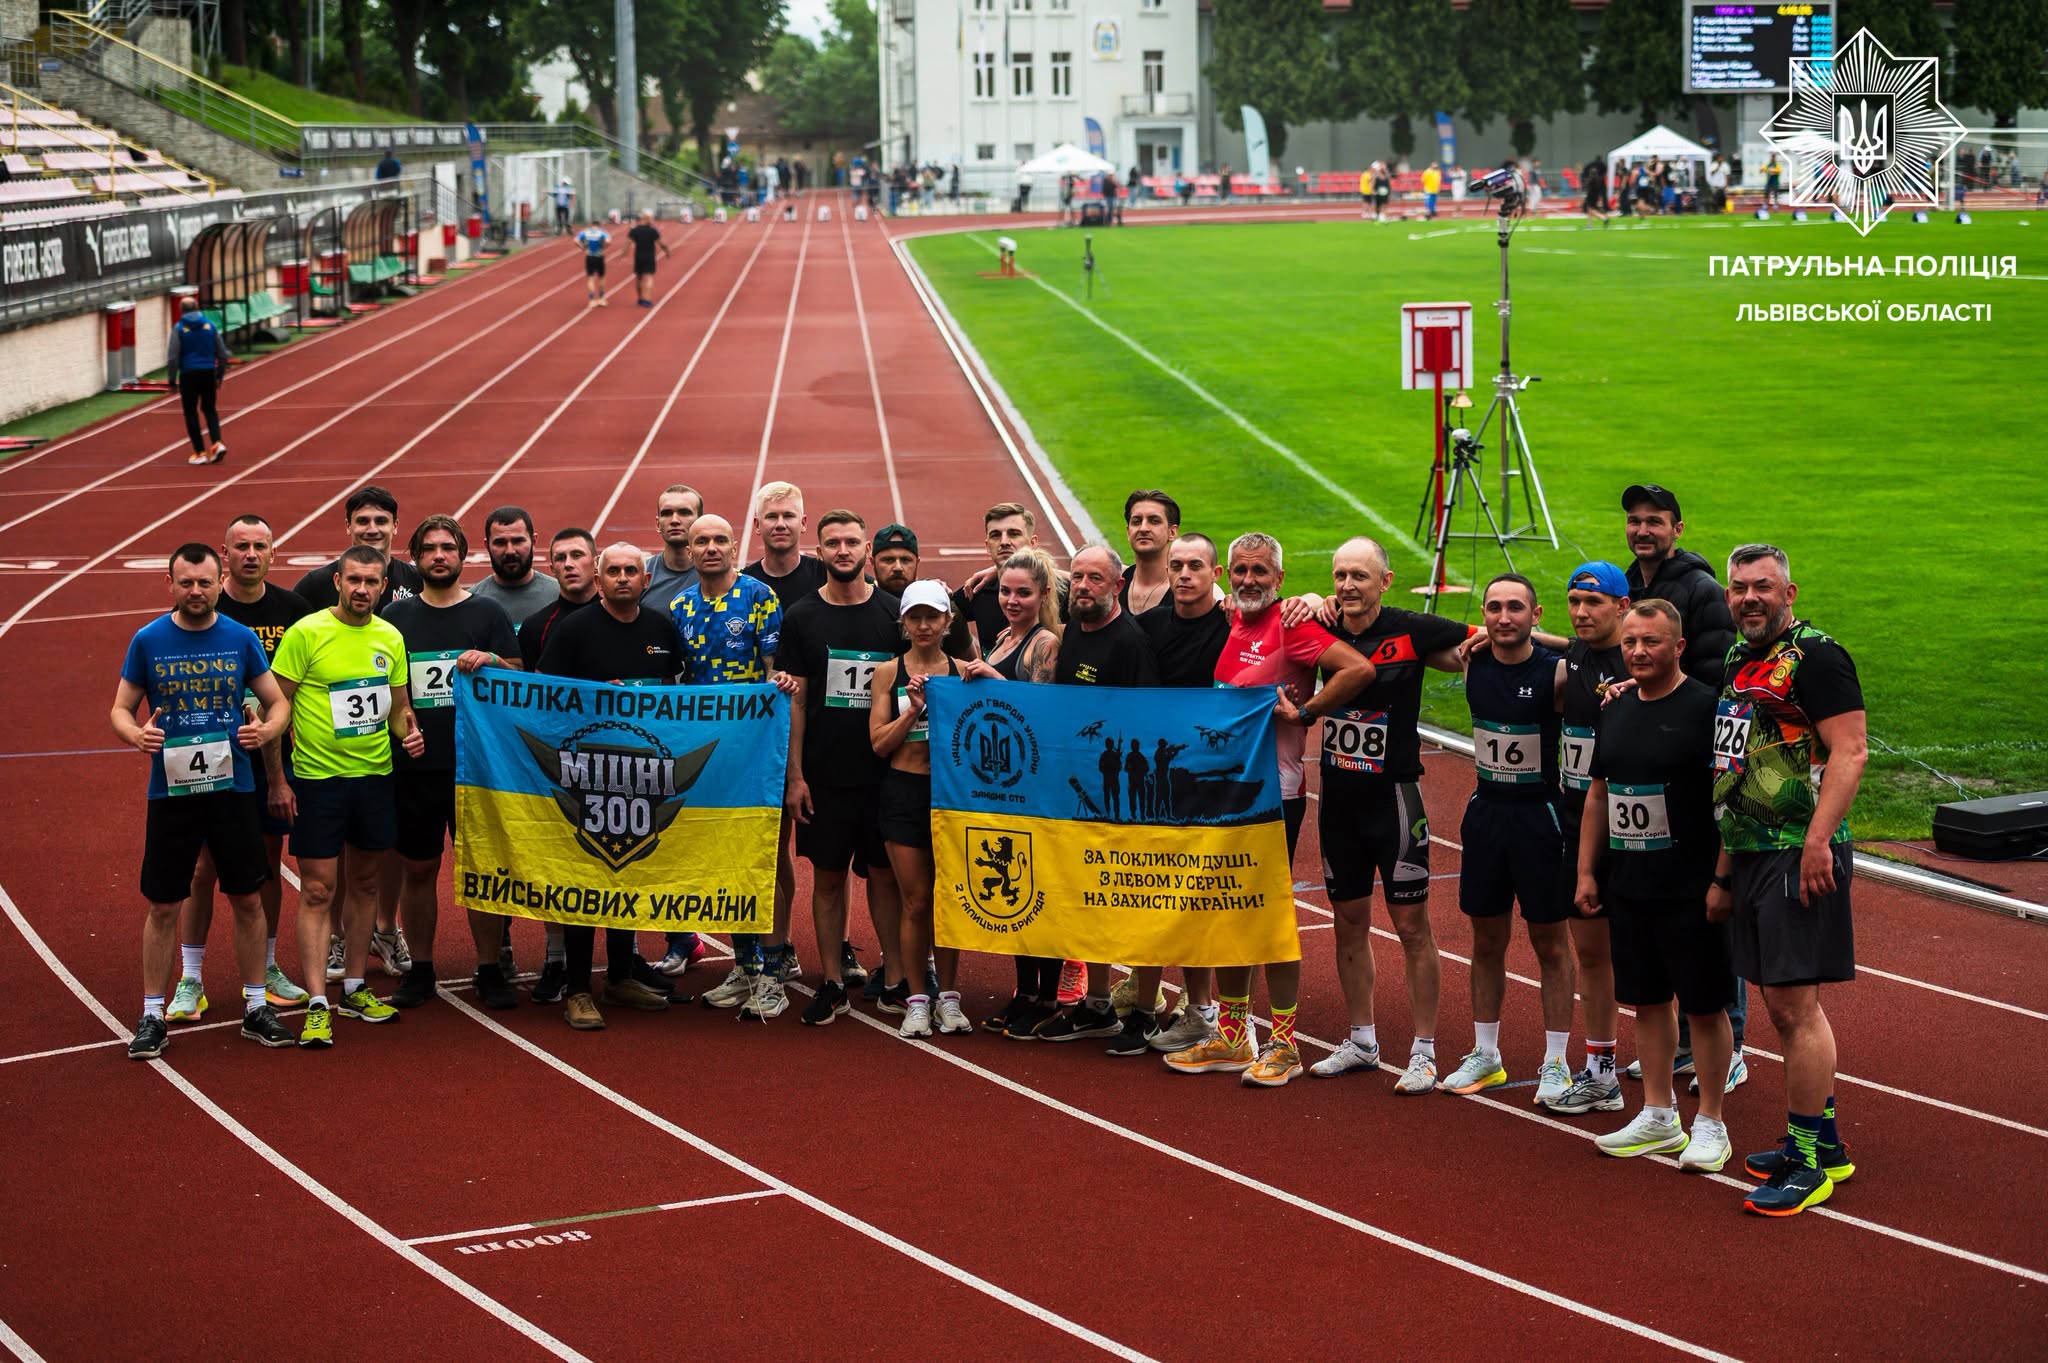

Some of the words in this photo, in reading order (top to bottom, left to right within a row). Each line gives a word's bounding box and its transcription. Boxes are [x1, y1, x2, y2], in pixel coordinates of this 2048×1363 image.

[249, 626, 285, 639] TUS
[155, 658, 238, 678] STRONG
[844, 666, 875, 690] 12
[347, 692, 379, 718] 31
[472, 676, 585, 715] СПІЛКА
[595, 689, 777, 722] ПОРАНЕНИХ
[952, 699, 984, 767] НАЦІОНАЛЬНА
[986, 698, 1025, 724] ГВАРДІЯ
[1024, 724, 1041, 775] УКРАЇНИ
[1325, 719, 1385, 757] 208
[1714, 717, 1745, 756] 226
[189, 750, 209, 774] 4
[1486, 738, 1524, 765] 16
[1563, 741, 1583, 769] 17
[557, 750, 676, 799] МІЦНІ
[1500, 765, 1537, 773] Олександр
[584, 796, 651, 836] 300
[1616, 802, 1650, 830] 30
[1644, 830, 1667, 839] Сергій
[1084, 849, 1106, 865] ЗА
[1109, 851, 1200, 868] ПОКЛИКОМ
[463, 867, 640, 919] ВІЙСЬКОВИХ
[649, 888, 757, 922] УКРАЇНИ
[1100, 871, 1110, 886] З
[1113, 872, 1171, 889] ЛЕВОМ
[1174, 875, 1184, 890] У
[1186, 875, 1243, 892] СЕРЦІ,
[958, 895, 1008, 933] ГАЛИЦЬКА
[1011, 890, 1045, 933] БРИГАДА
[1084, 892, 1107, 907] НА
[1110, 893, 1177, 910] ЗАХИСТІ
[1179, 892, 1265, 912] УКРАЇНИ!
[1230, 1011, 1248, 1020] RU
[454, 1229, 592, 1255] 800m
